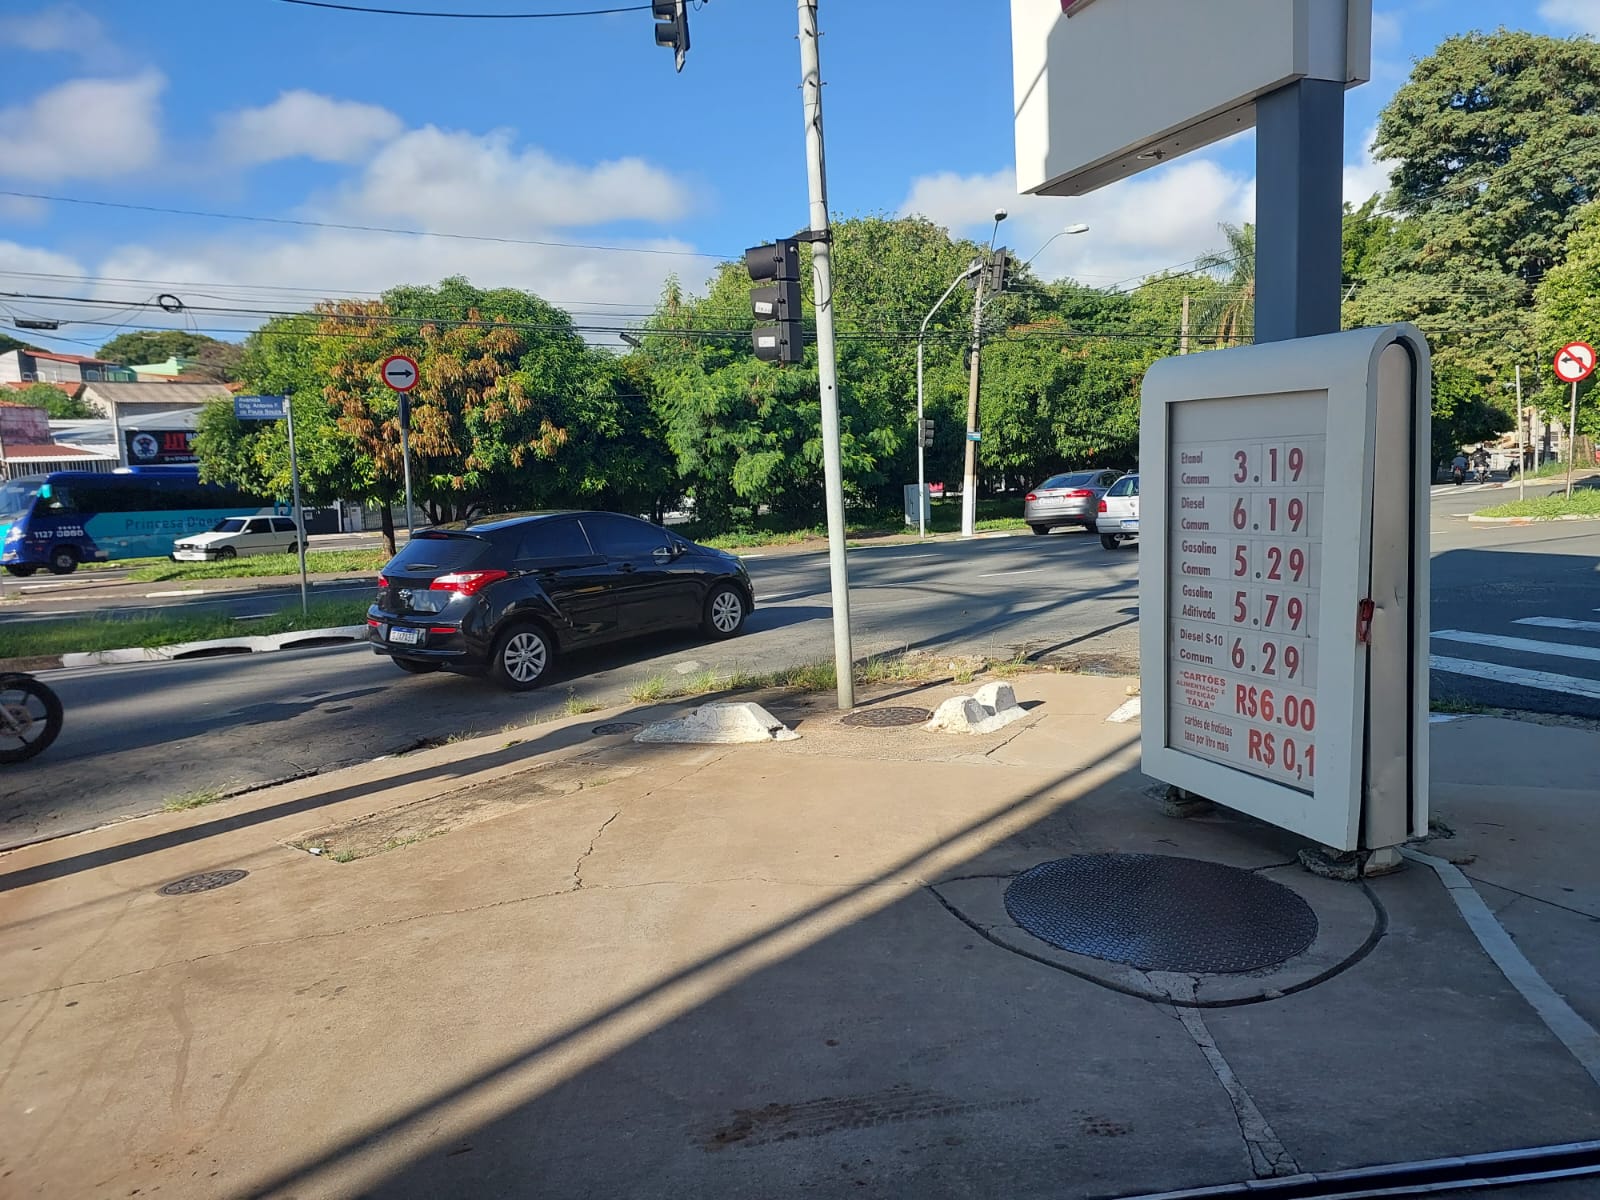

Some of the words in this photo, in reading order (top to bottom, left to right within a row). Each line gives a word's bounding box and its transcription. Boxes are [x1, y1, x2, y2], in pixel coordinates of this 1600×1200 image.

[1181, 451, 1203, 465] Etanol
[1234, 447, 1303, 483] 3.19
[1181, 473, 1210, 485] Comum
[1181, 496, 1205, 509] Diesel
[1233, 498, 1304, 533] 6.19
[125, 518, 184, 530] Princesa
[1181, 518, 1210, 530] Comum
[34, 530, 53, 539] 1127
[1182, 540, 1217, 555] Gasolina
[1181, 561, 1211, 576] Comum
[1234, 545, 1305, 582] 5.29
[1182, 584, 1213, 599] Gasolina
[1182, 604, 1216, 620] Aditivada
[1233, 591, 1303, 631] 5.79
[1180, 628, 1204, 644] Diesel
[1205, 633, 1224, 647] S-10
[1179, 648, 1214, 665] Comum
[1231, 637, 1300, 679] 6.29
[1184, 715, 1204, 729] cartões
[1203, 719, 1211, 731] de
[1210, 720, 1233, 737] frotistas
[1184, 730, 1196, 742] taxa
[1196, 734, 1205, 745] por
[1216, 740, 1230, 752] mais
[1249, 729, 1276, 768] R$
